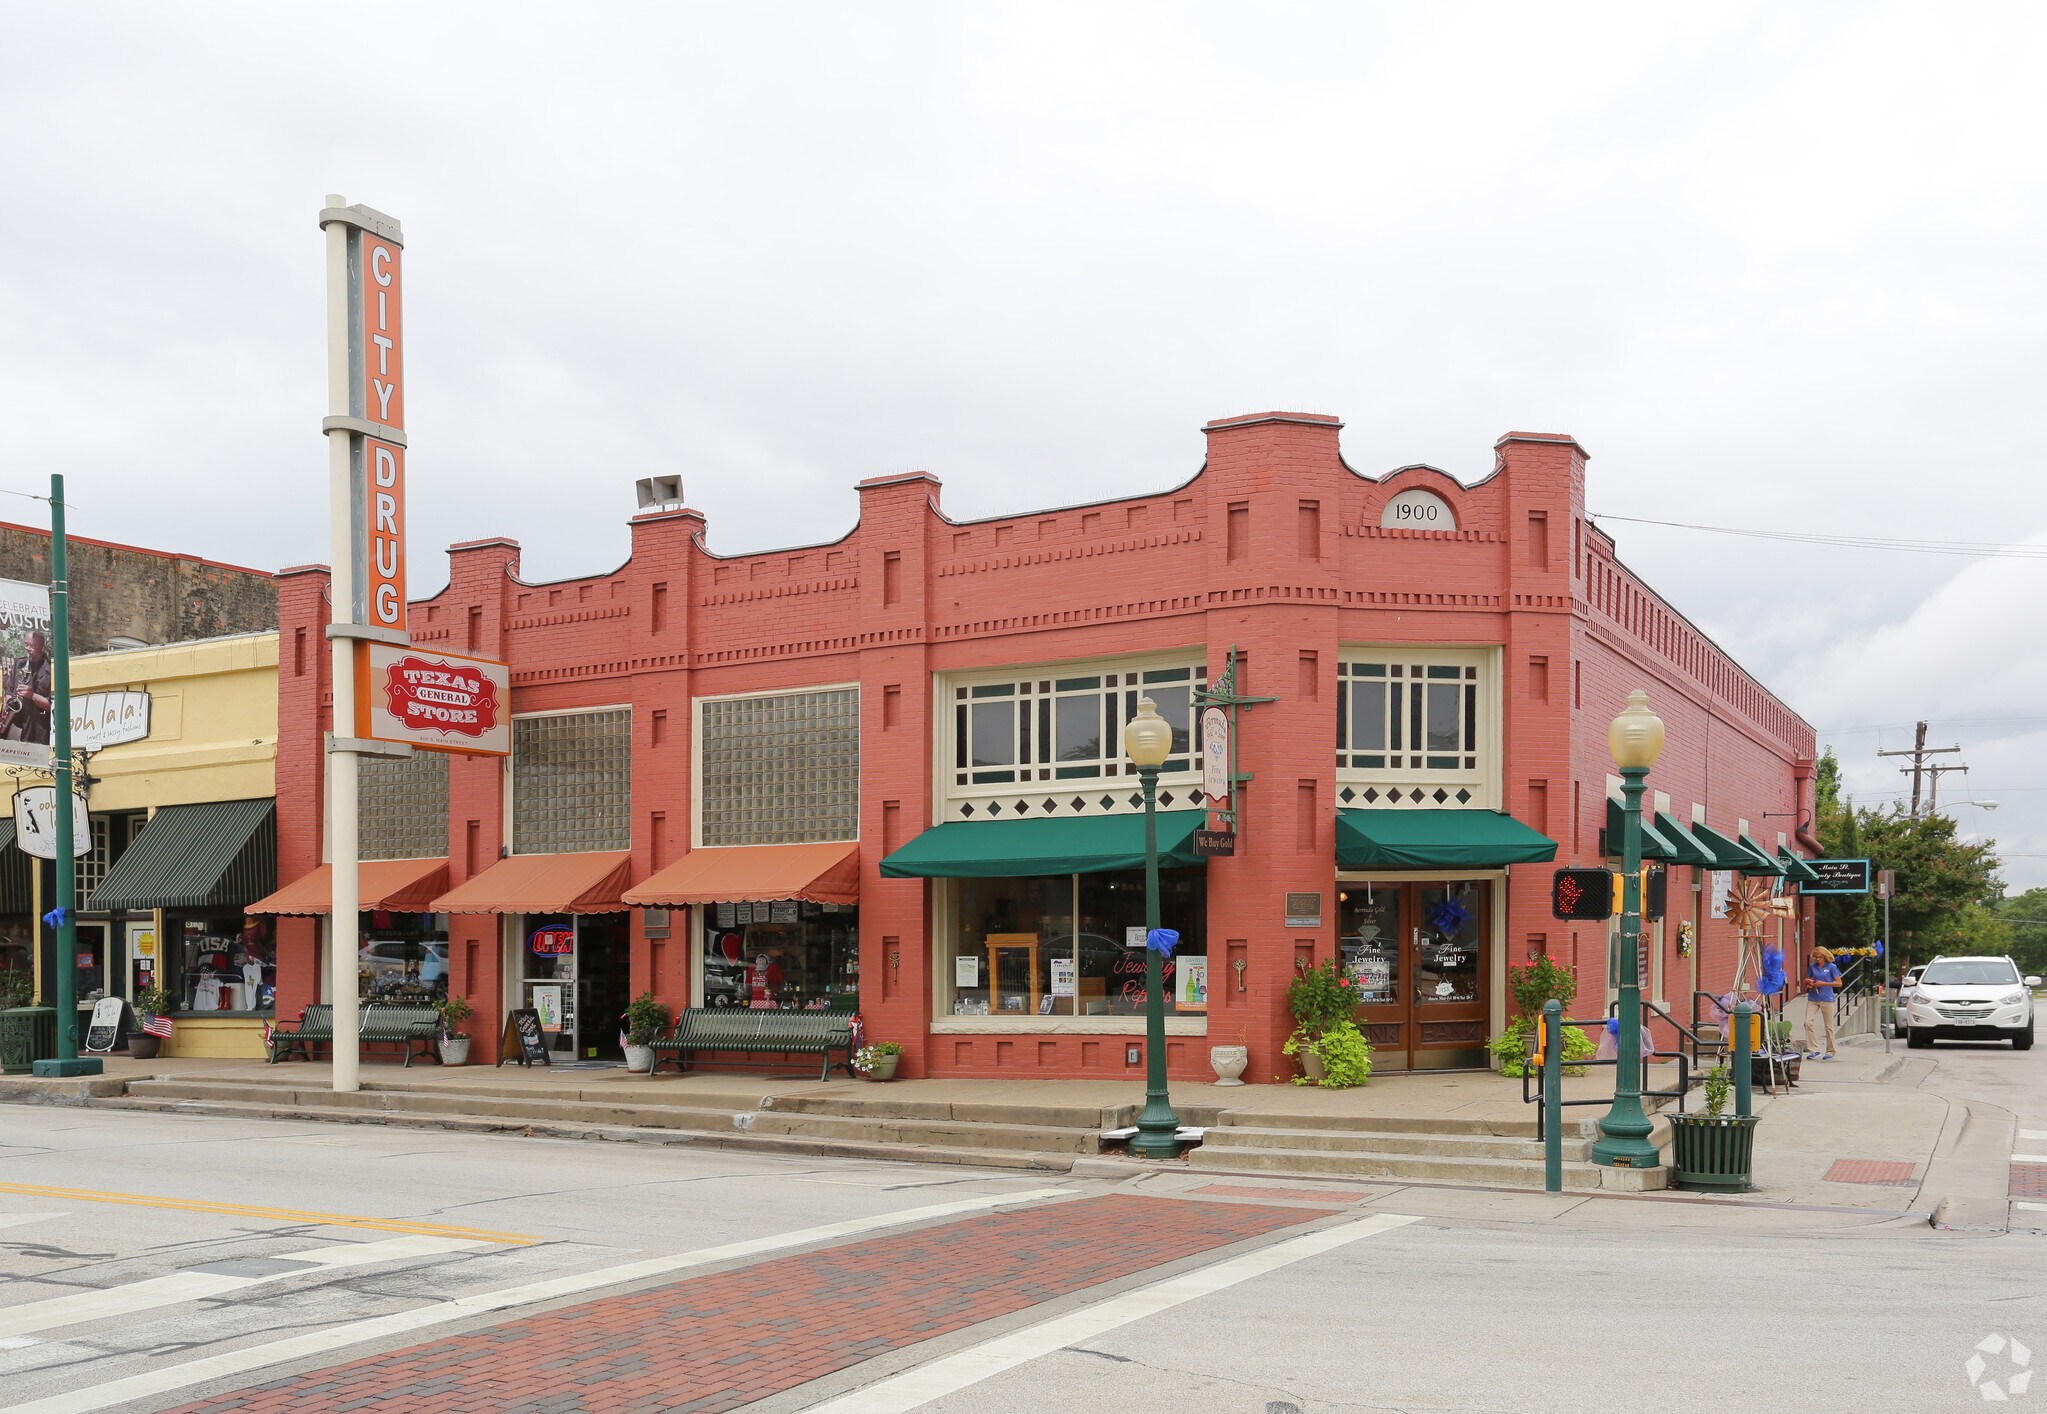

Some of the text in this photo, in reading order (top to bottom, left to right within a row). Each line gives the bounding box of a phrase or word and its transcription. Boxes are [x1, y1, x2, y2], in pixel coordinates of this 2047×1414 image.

[371, 244, 399, 624] CITY DRUG
[1395, 504, 1437, 520] 1900
[403, 669, 480, 694] TEXAS
[419, 689, 468, 704] GENERAL
[407, 701, 478, 723] STORE
[0, 748, 30, 757] RAPEVINE
[1198, 836, 1233, 850] We Buy Gold
[1832, 871, 1862, 880] Boutique
[1374, 905, 1386, 914] Gold
[199, 936, 231, 953] USA
[1357, 944, 1381, 956] Fine
[1438, 943, 1462, 954] Fine
[1352, 955, 1386, 963] Jewelry
[1433, 954, 1467, 963] Jewelry
[1422, 1023, 1479, 1041] BANK
